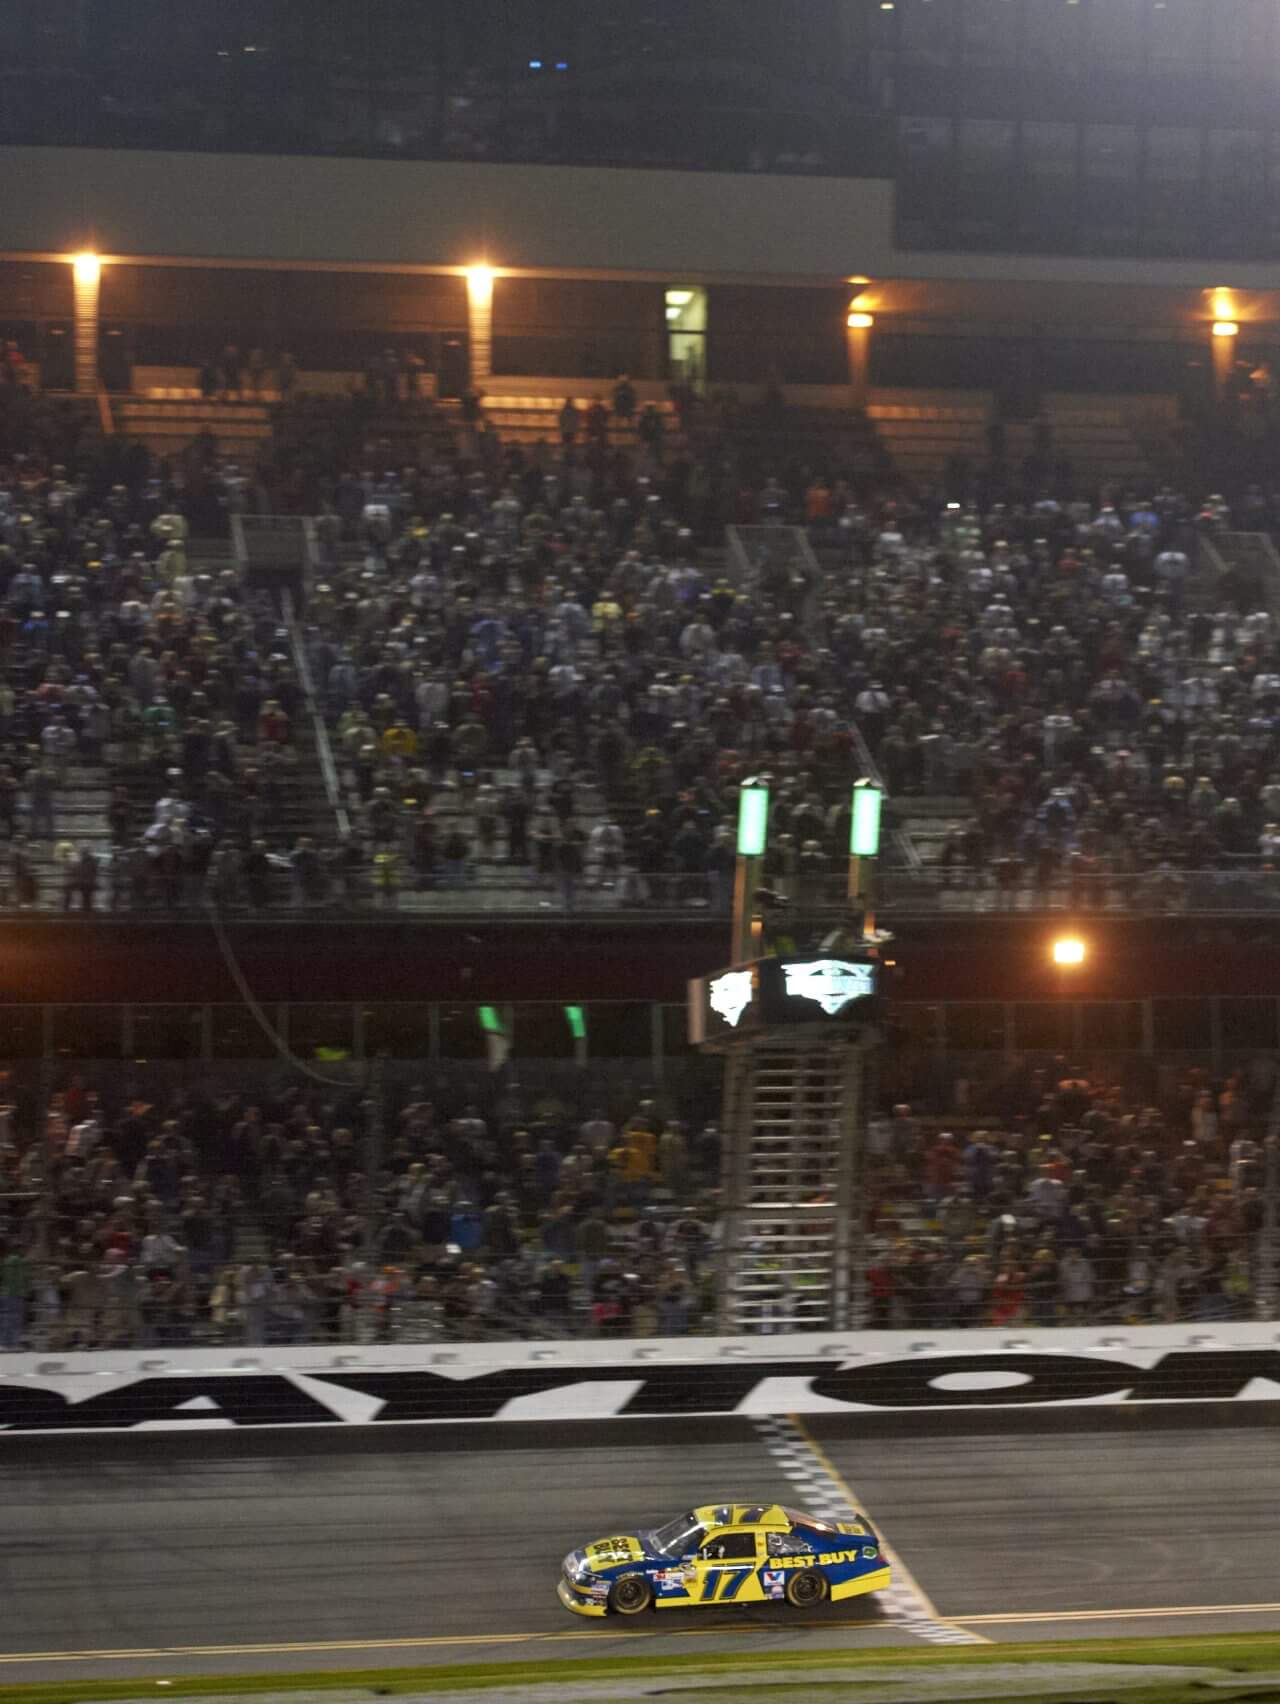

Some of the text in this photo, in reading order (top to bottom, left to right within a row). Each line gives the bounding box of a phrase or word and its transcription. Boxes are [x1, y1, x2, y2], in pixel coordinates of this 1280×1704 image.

[769, 1549, 858, 1569] BEST BUY
[699, 1562, 755, 1601] 17
